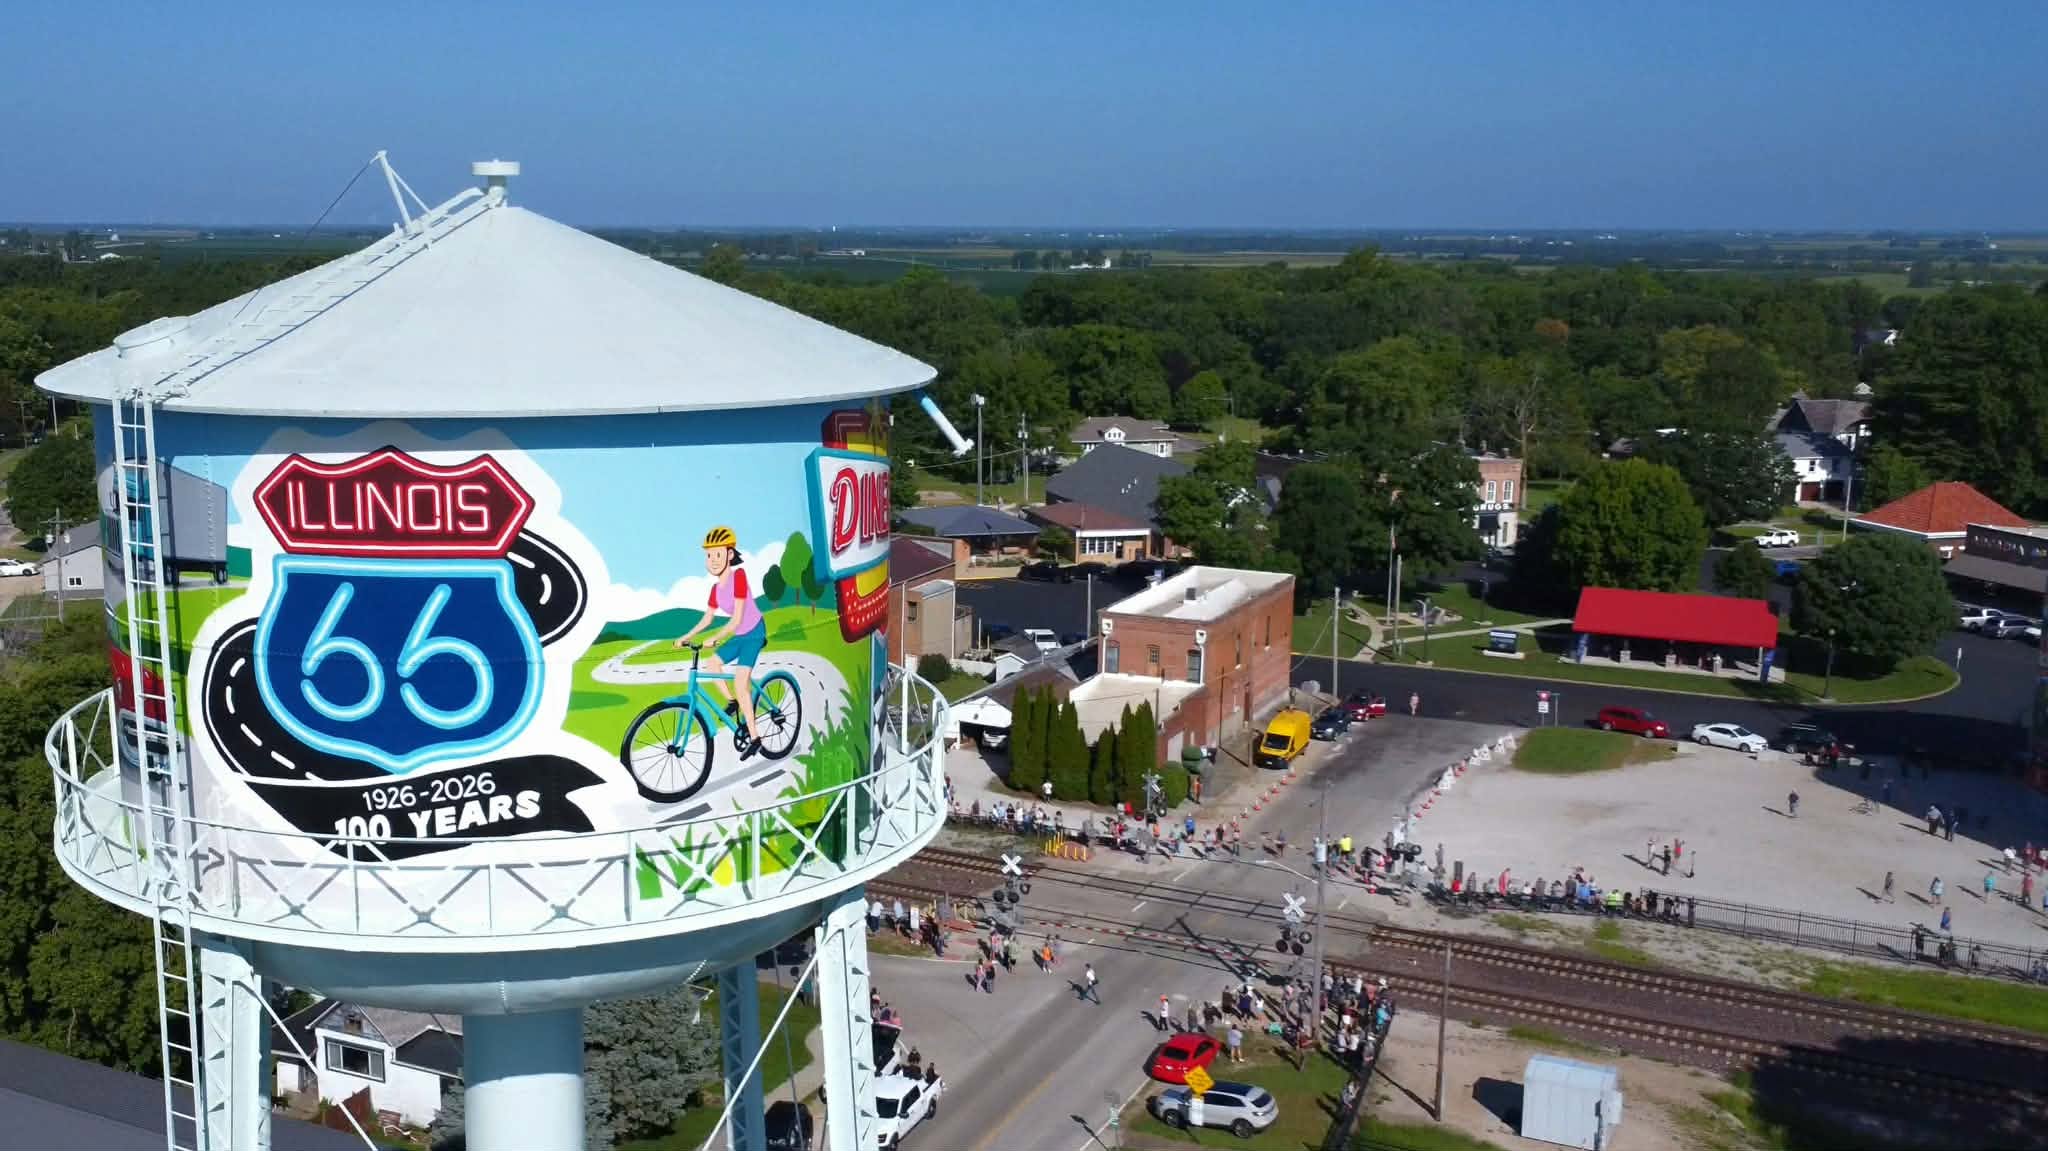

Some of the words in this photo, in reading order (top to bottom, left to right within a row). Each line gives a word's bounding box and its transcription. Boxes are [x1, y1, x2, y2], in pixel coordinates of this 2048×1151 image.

[287, 481, 490, 532] ILLINOIS
[300, 581, 495, 730] 66
[334, 814, 392, 846] 100
[408, 790, 541, 838] YEARS
